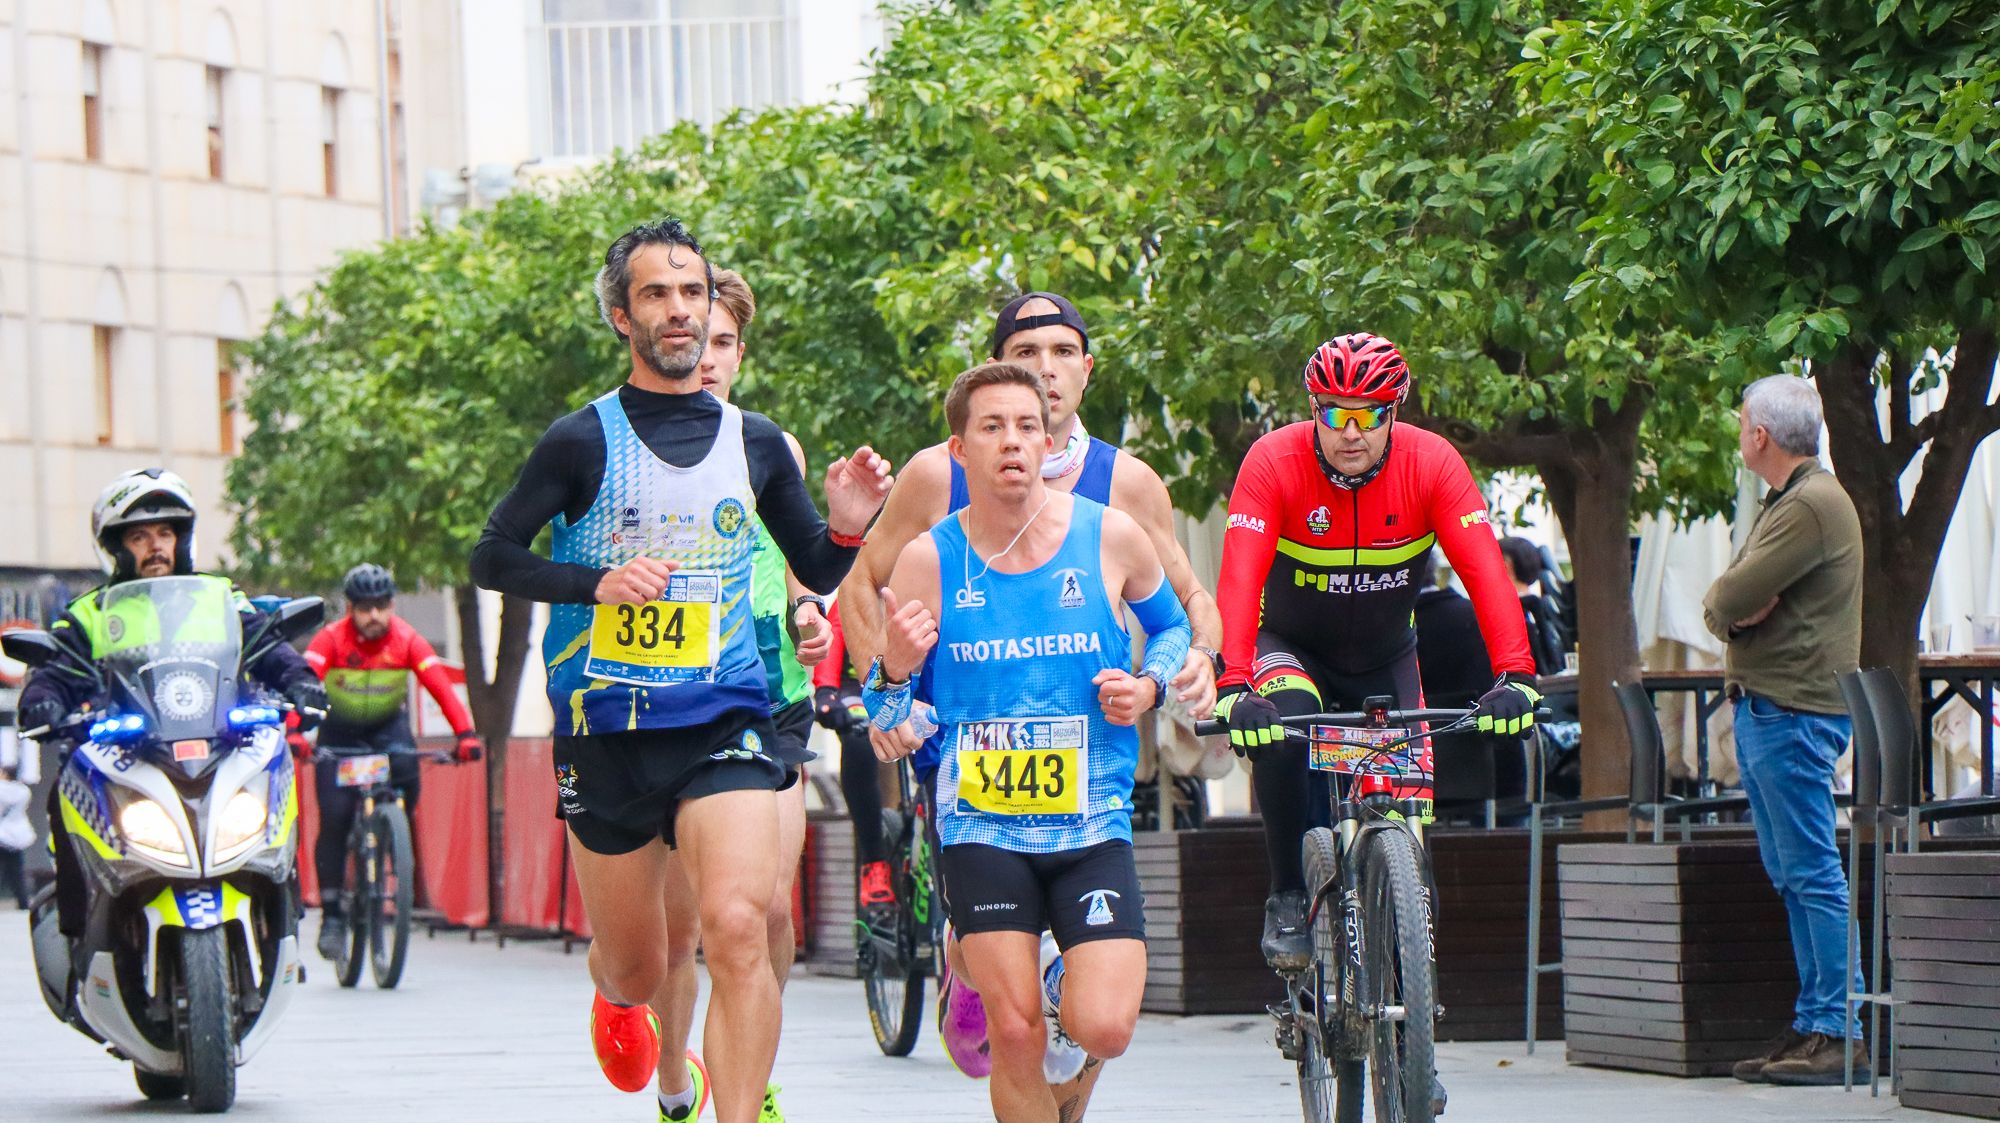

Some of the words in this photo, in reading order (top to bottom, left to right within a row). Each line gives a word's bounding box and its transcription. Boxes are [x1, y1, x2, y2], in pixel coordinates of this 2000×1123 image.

[1328, 580, 1409, 594] LUCENA
[1329, 568, 1410, 586] MILAR
[616, 603, 686, 649] 334
[949, 632, 1101, 662] TROTASIERRA
[976, 723, 1011, 750] 21K
[975, 754, 1064, 799] 1443
[1344, 965, 1355, 1005] BMC
